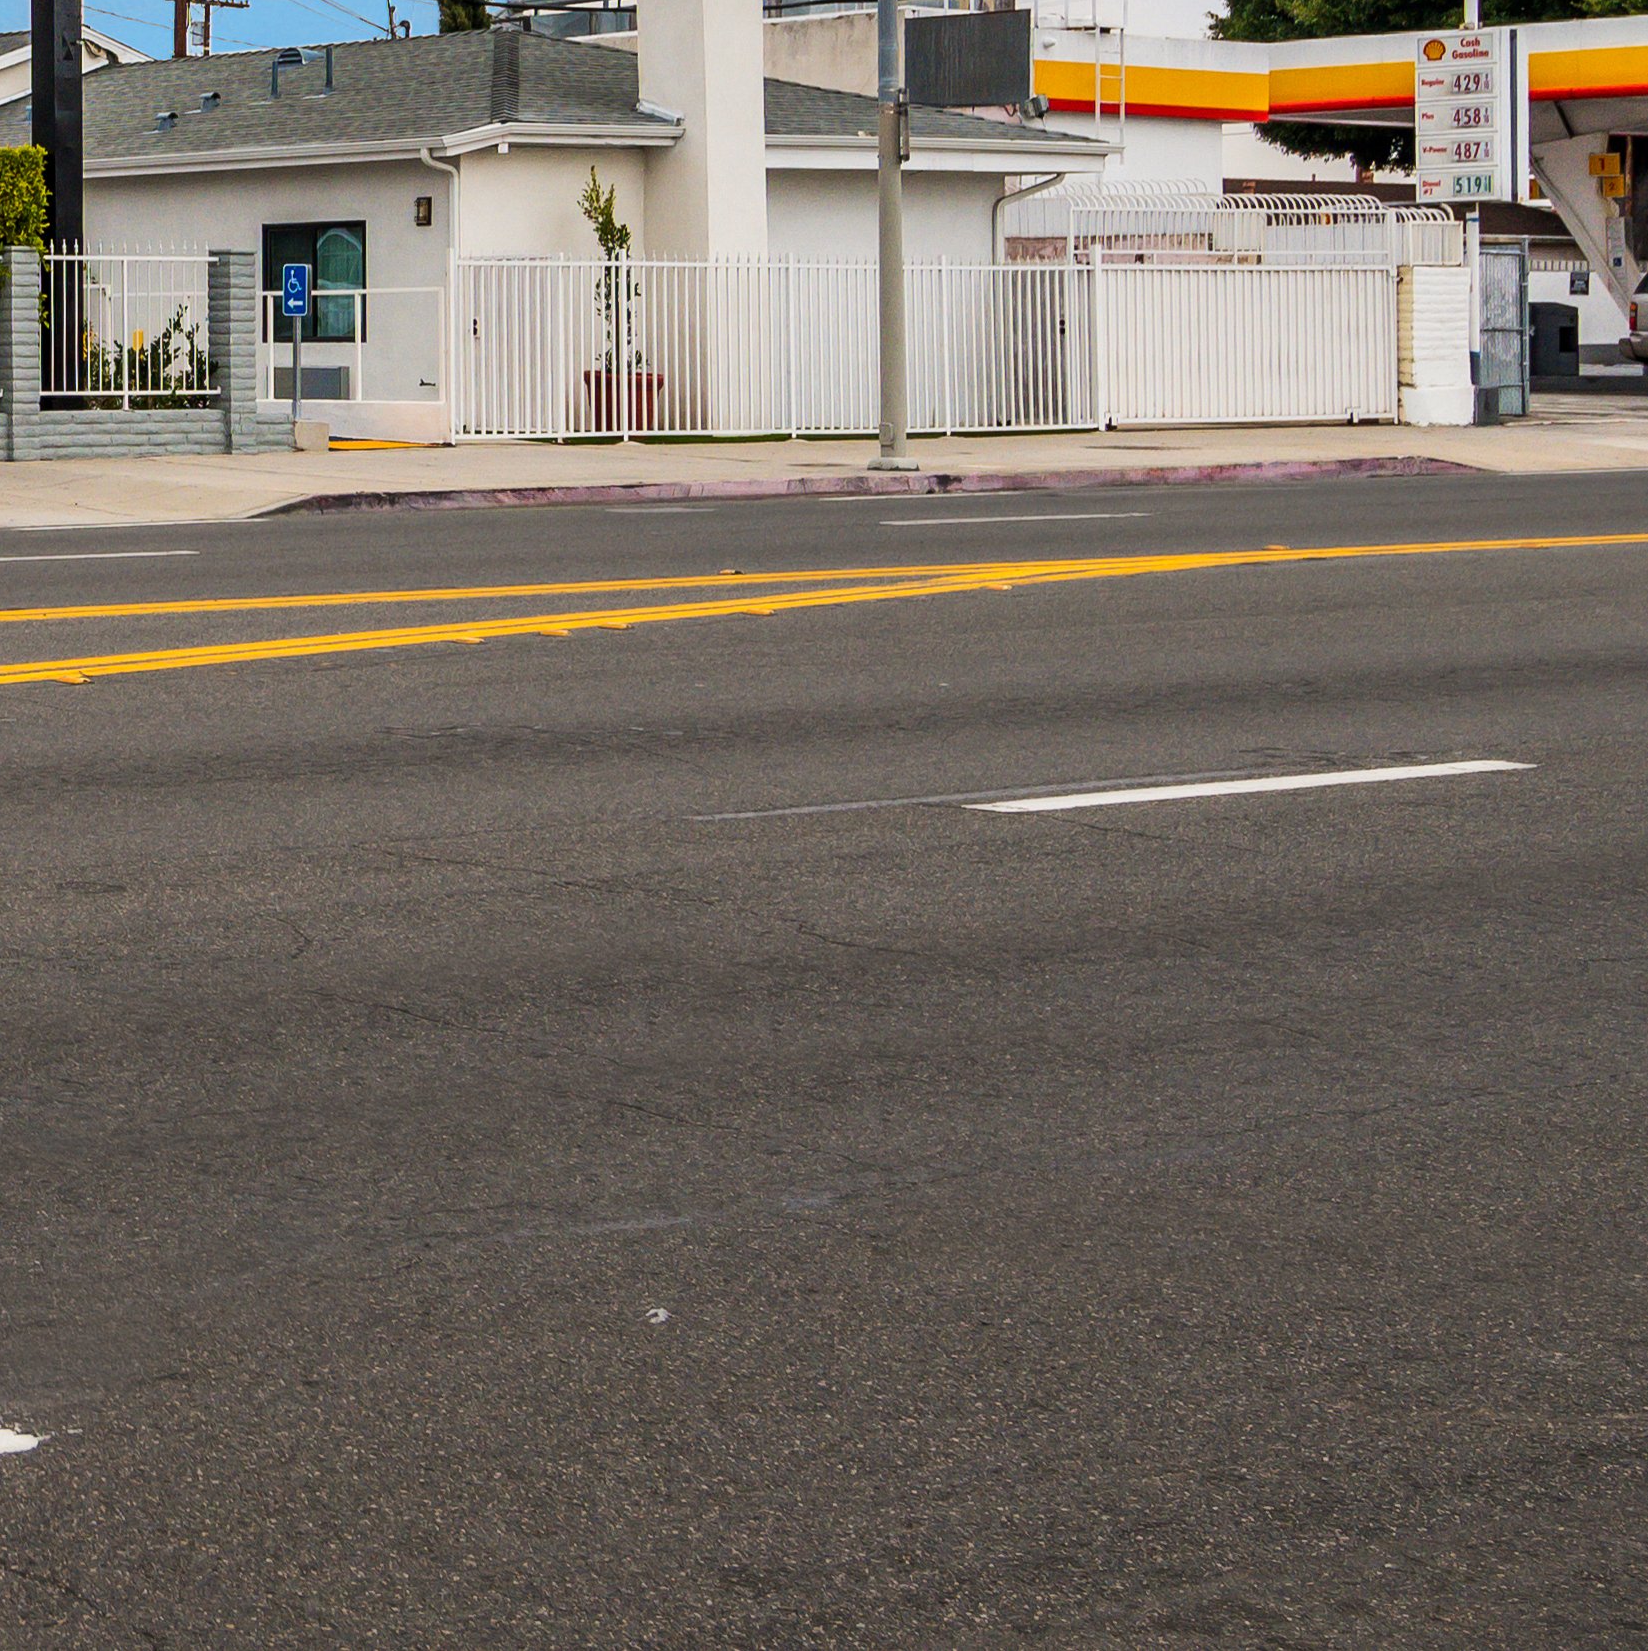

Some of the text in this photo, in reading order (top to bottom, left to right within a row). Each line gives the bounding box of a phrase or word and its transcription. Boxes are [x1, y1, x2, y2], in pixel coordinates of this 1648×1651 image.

[1460, 37, 1481, 48] Cash
[1452, 48, 1489, 60] Gasoline
[1453, 73, 1481, 92] 429
[1453, 108, 1481, 126] 458
[1454, 141, 1481, 160] 487
